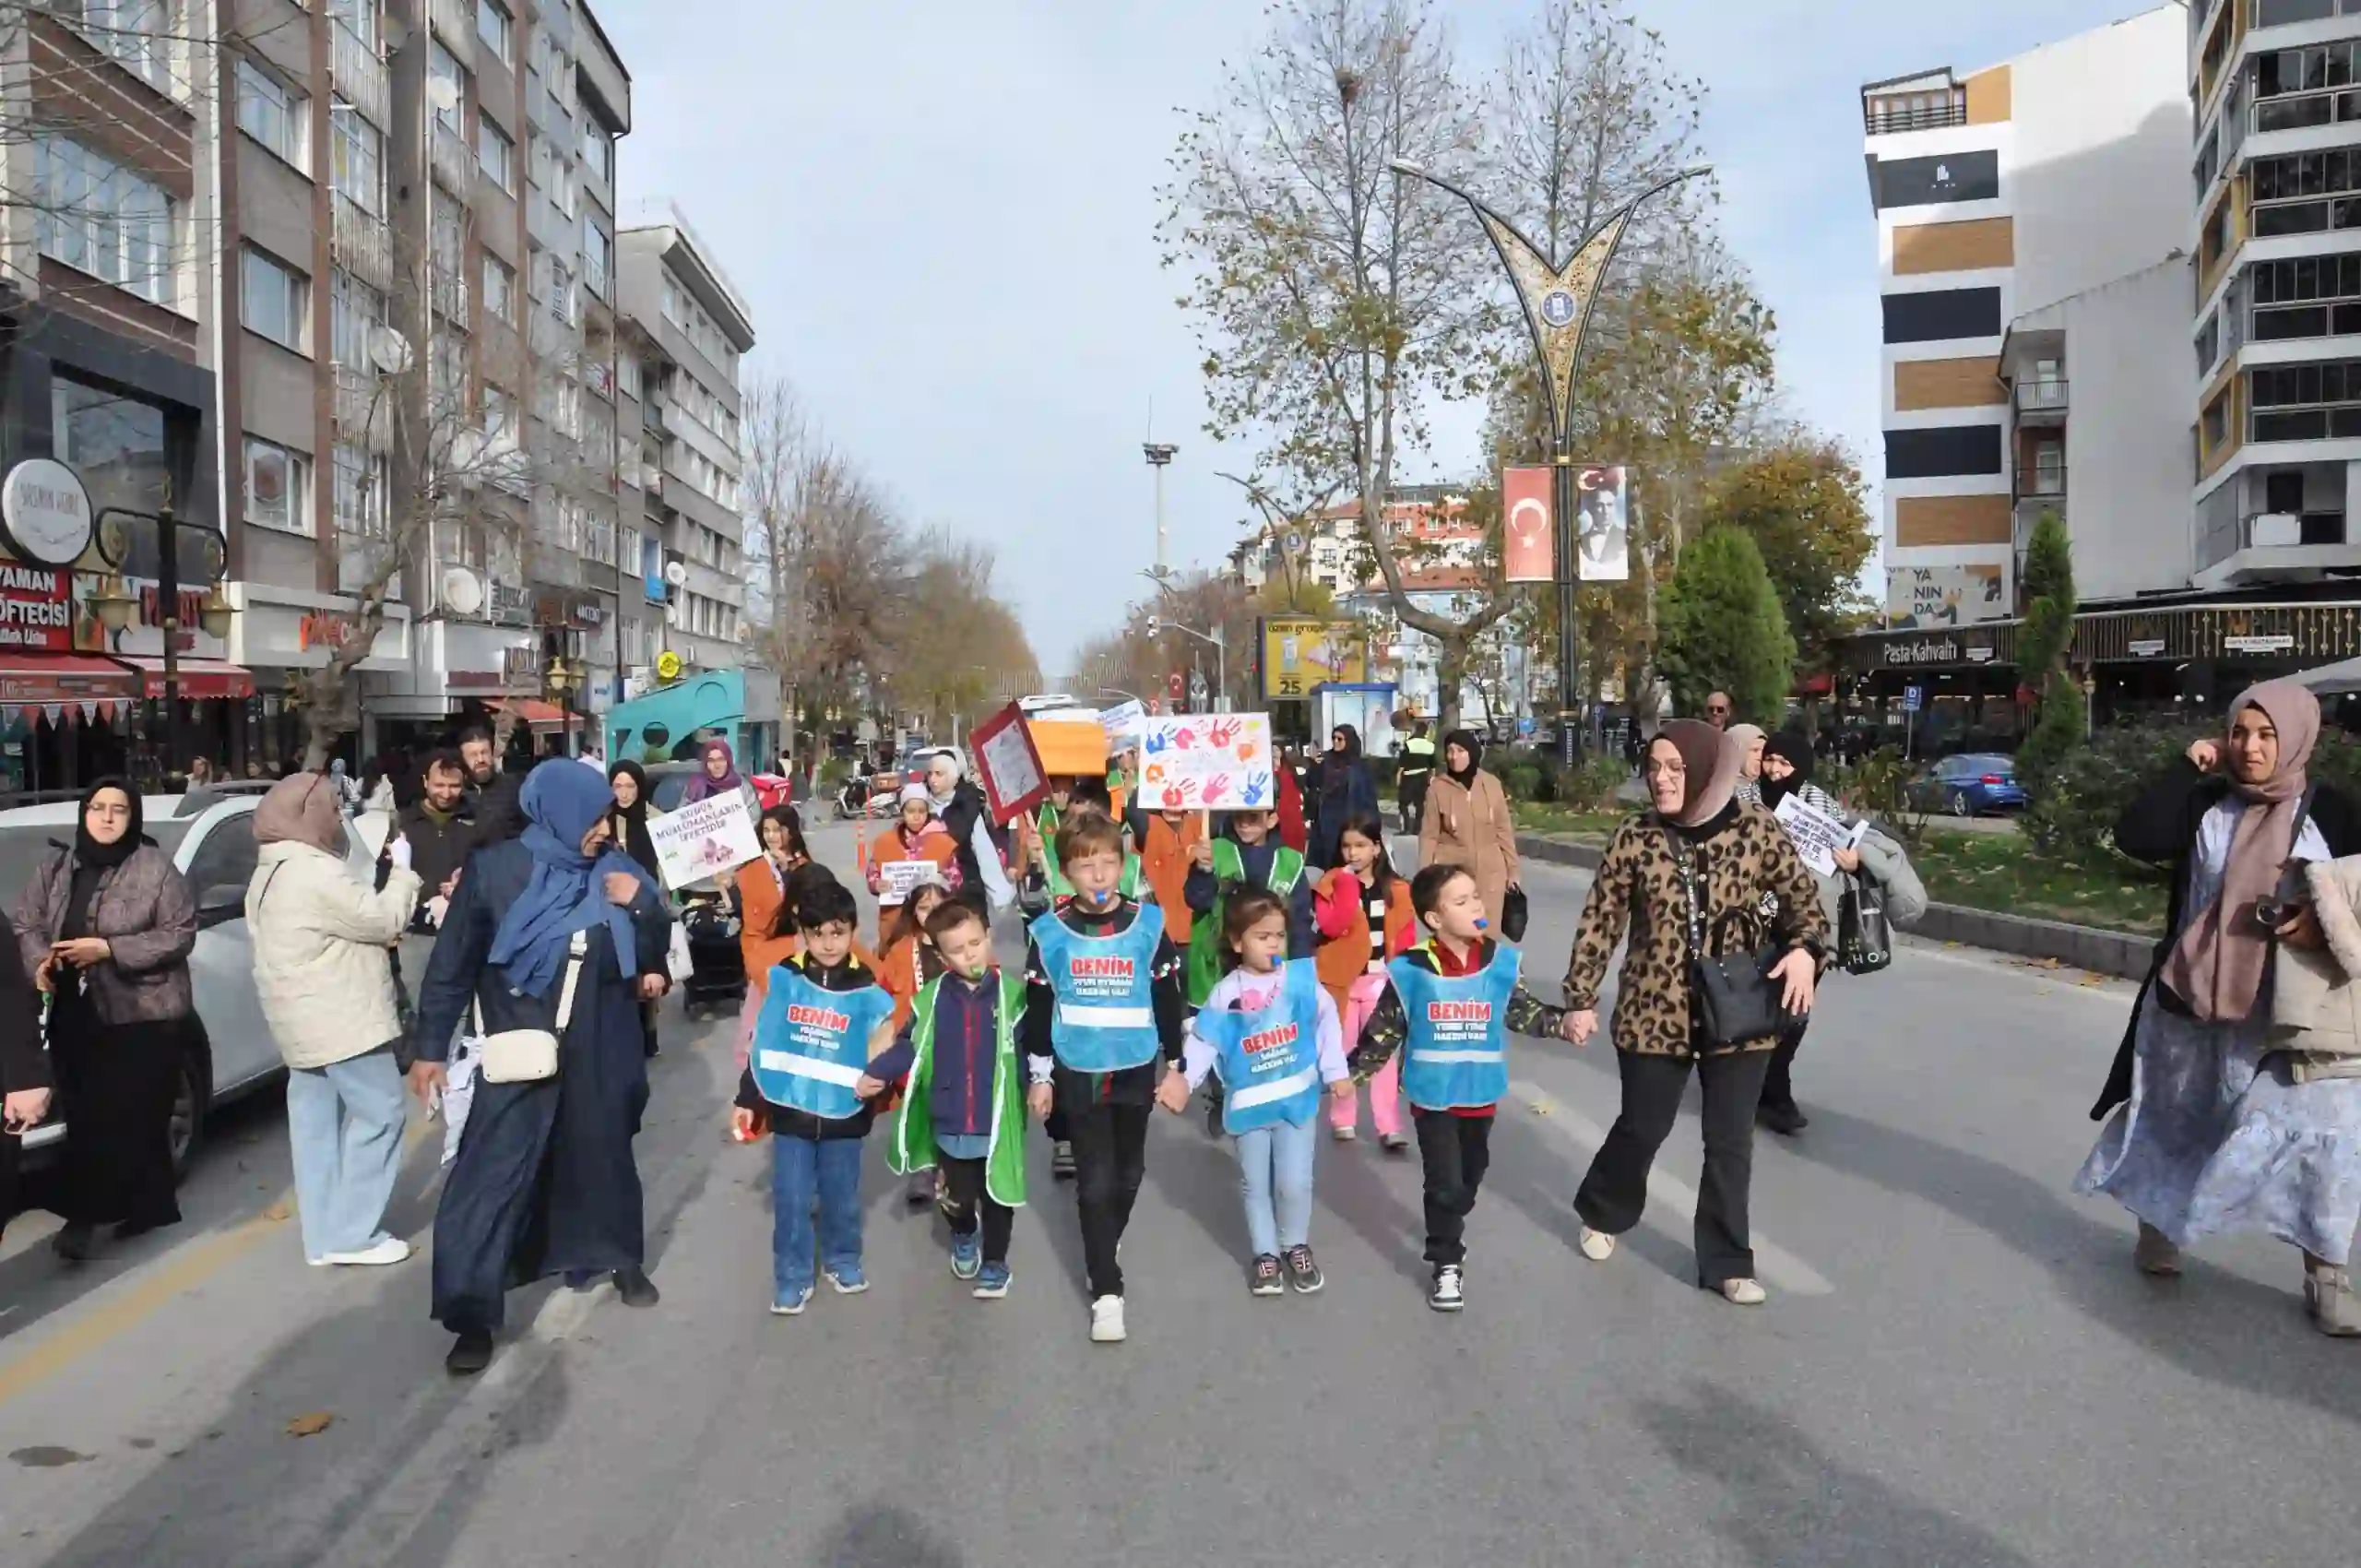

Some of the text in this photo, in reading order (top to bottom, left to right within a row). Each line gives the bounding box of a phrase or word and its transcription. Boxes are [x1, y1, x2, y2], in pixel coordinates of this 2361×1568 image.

[1279, 679, 1302, 695] 25
[1071, 955, 1133, 977] BENİM
[788, 1004, 850, 1033] BENİM
[1428, 1000, 1491, 1021] BENİM
[1241, 1023, 1298, 1053] BENİM
